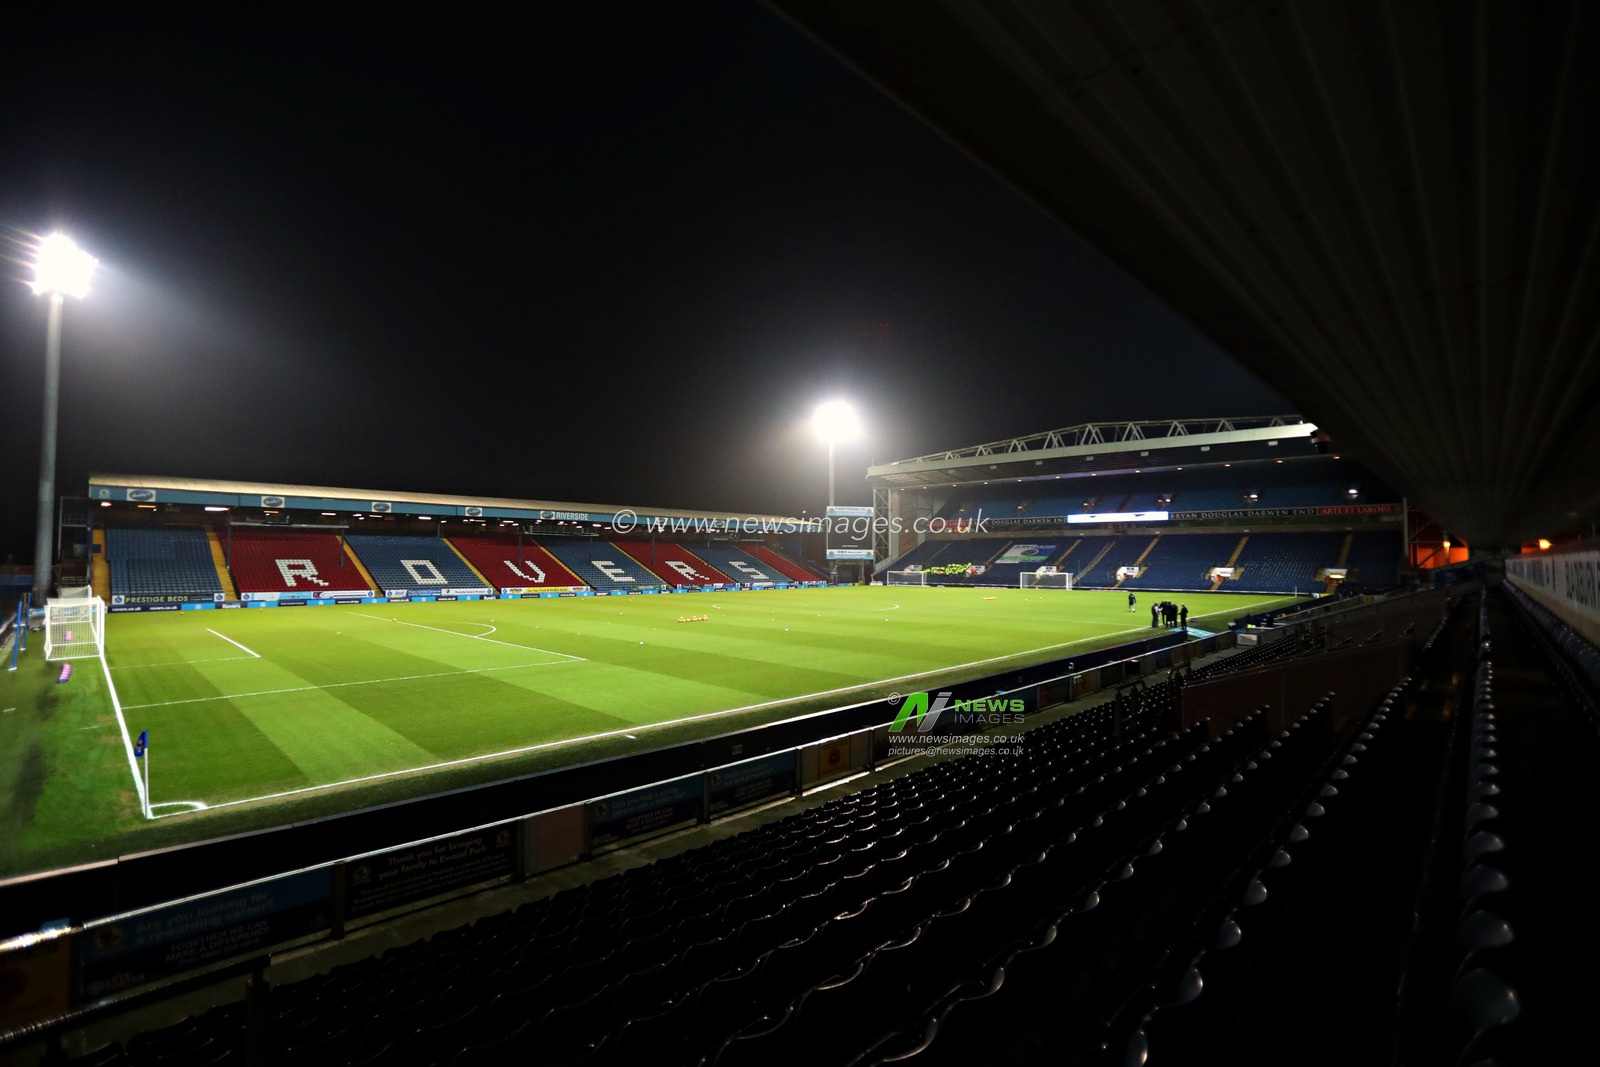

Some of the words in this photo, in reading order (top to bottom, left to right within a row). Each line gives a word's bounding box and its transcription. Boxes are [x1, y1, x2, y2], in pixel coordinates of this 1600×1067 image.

[555, 511, 589, 520] RIVERSIDE
[1170, 512, 1197, 520] BRYAN
[1201, 511, 1244, 519] DOUGLAS
[1248, 509, 1289, 518] DARWEN
[1293, 508, 1315, 516] END
[125, 595, 164, 604] PRESTIGE
[378, 869, 398, 881] your
[401, 860, 427, 873] family
[429, 858, 438, 866] to
[439, 849, 467, 863] Ewood
[387, 852, 414, 867] Thank
[416, 849, 433, 861] you
[434, 845, 447, 854] for
[449, 836, 483, 850] bringing
[136, 919, 162, 933] Are
[166, 911, 193, 930] you
[197, 897, 248, 917] looking
[251, 891, 269, 907] for
[149, 914, 222, 942] rewarding
[225, 899, 275, 922] career?
[165, 947, 197, 962] MAKE
[209, 928, 271, 952] DIFFERENCE
[170, 931, 228, 953] TOGETHER
[229, 926, 245, 938] WE
[246, 920, 268, 933] CAN
